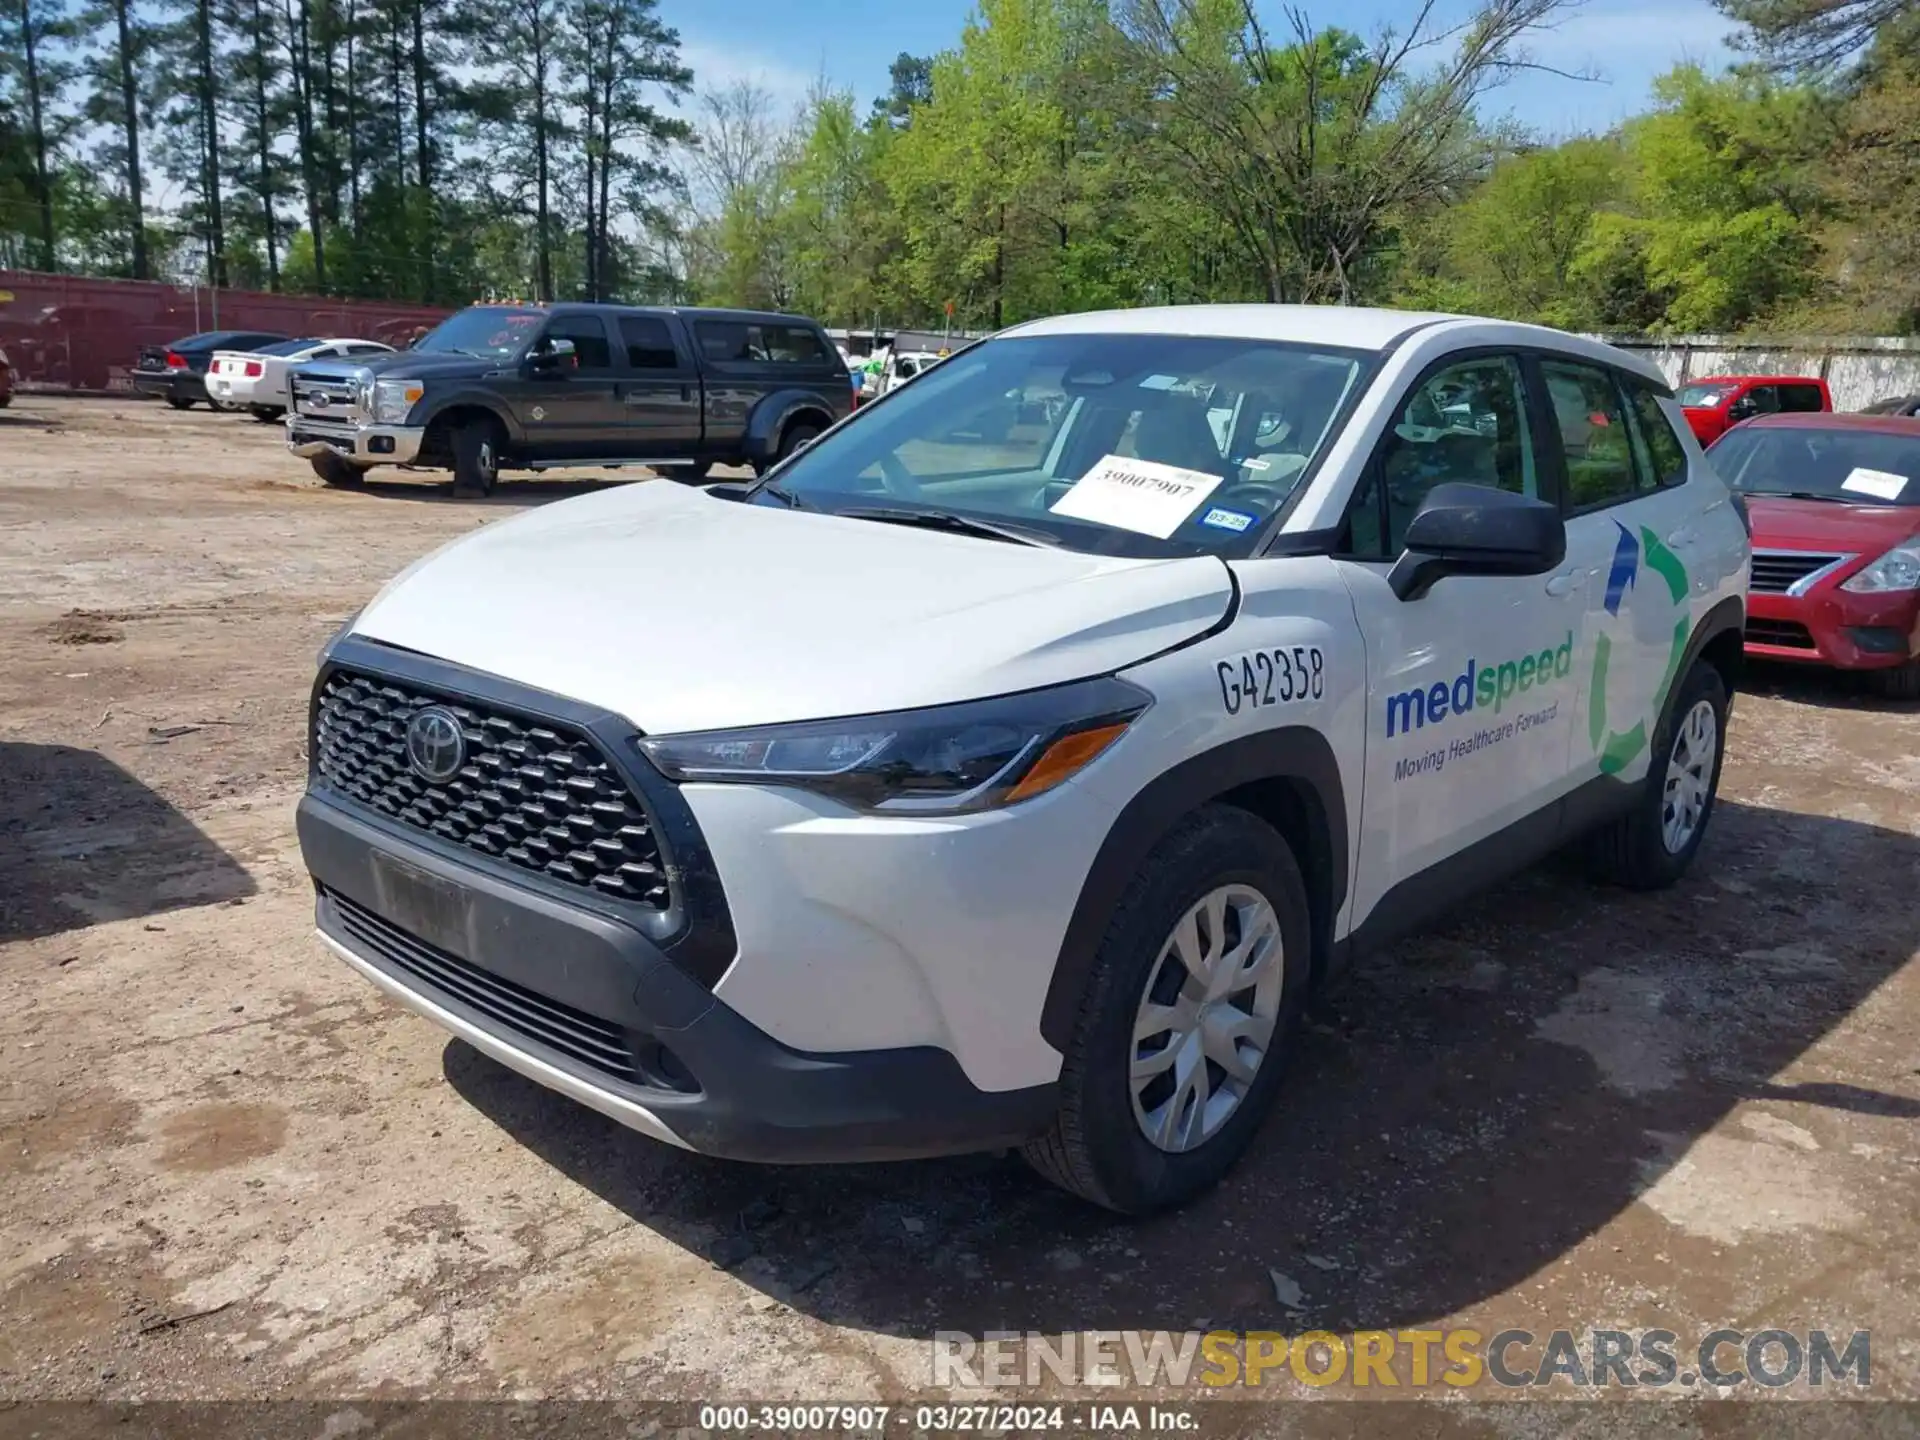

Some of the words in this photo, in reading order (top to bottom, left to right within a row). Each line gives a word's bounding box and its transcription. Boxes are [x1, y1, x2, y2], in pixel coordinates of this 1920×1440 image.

[1096, 468, 1196, 499] 39007907
[1216, 647, 1324, 715] G42358
[1386, 629, 1573, 738] medspeed
[1394, 748, 1446, 782] Moving
[1448, 721, 1513, 761] Healthcare
[1515, 700, 1559, 735] Forward
